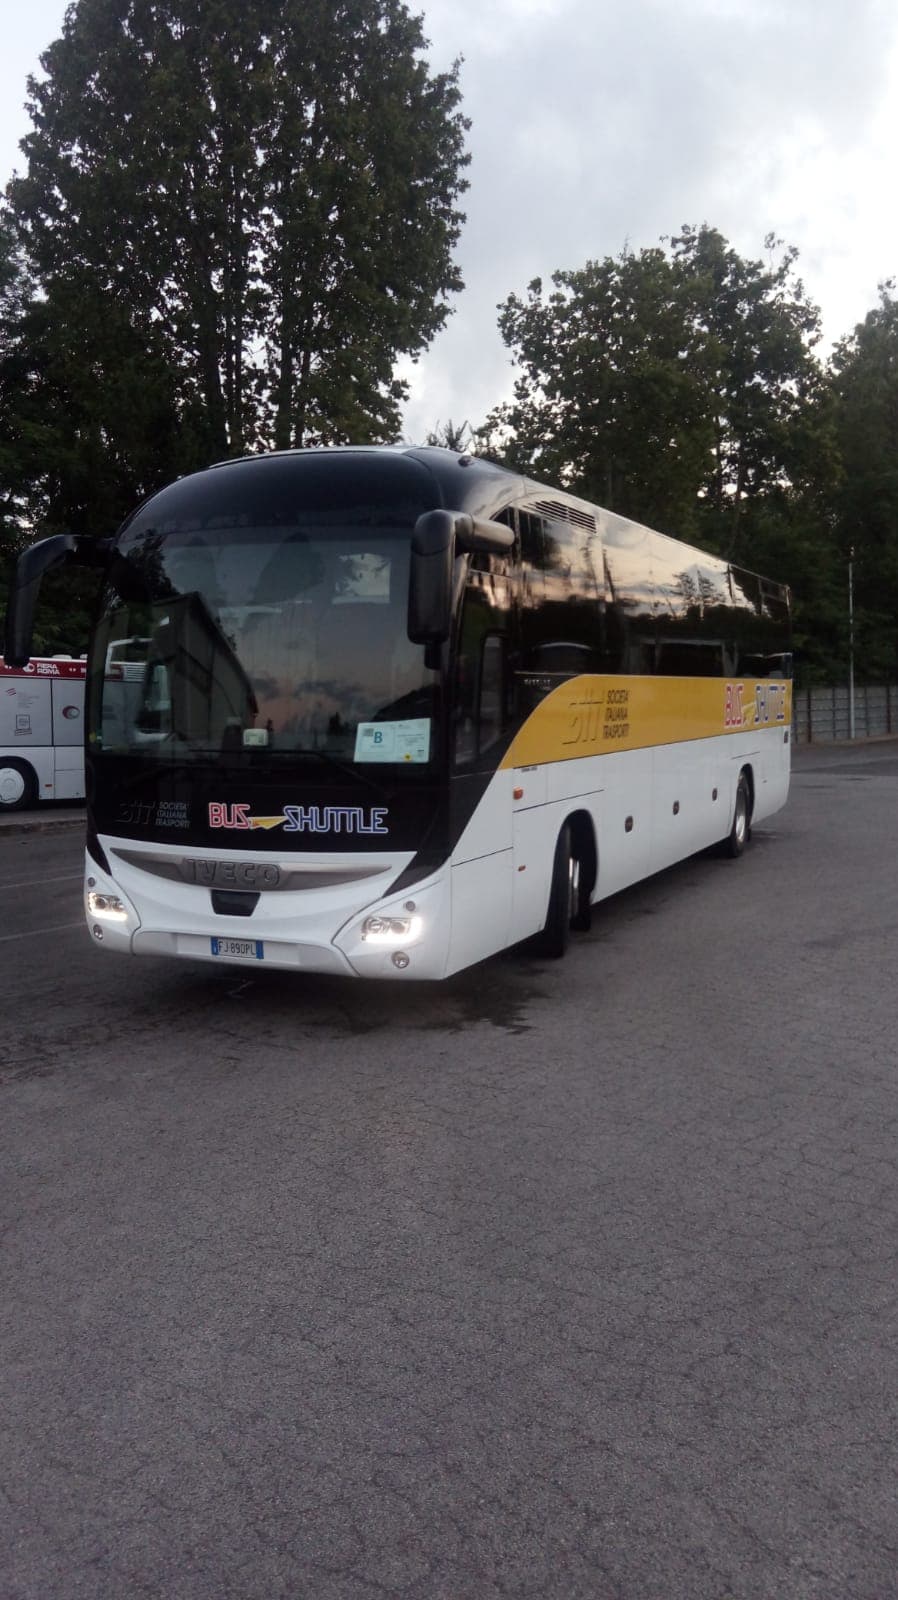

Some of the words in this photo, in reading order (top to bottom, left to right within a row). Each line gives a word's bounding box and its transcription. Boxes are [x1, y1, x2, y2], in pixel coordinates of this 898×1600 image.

[724, 683, 744, 728] BUS
[754, 683, 786, 724] SHUTTLE
[374, 731, 383, 744] B
[208, 802, 250, 829] BUS
[283, 805, 389, 834] SHUTTLE
[182, 858, 281, 886] IVECO
